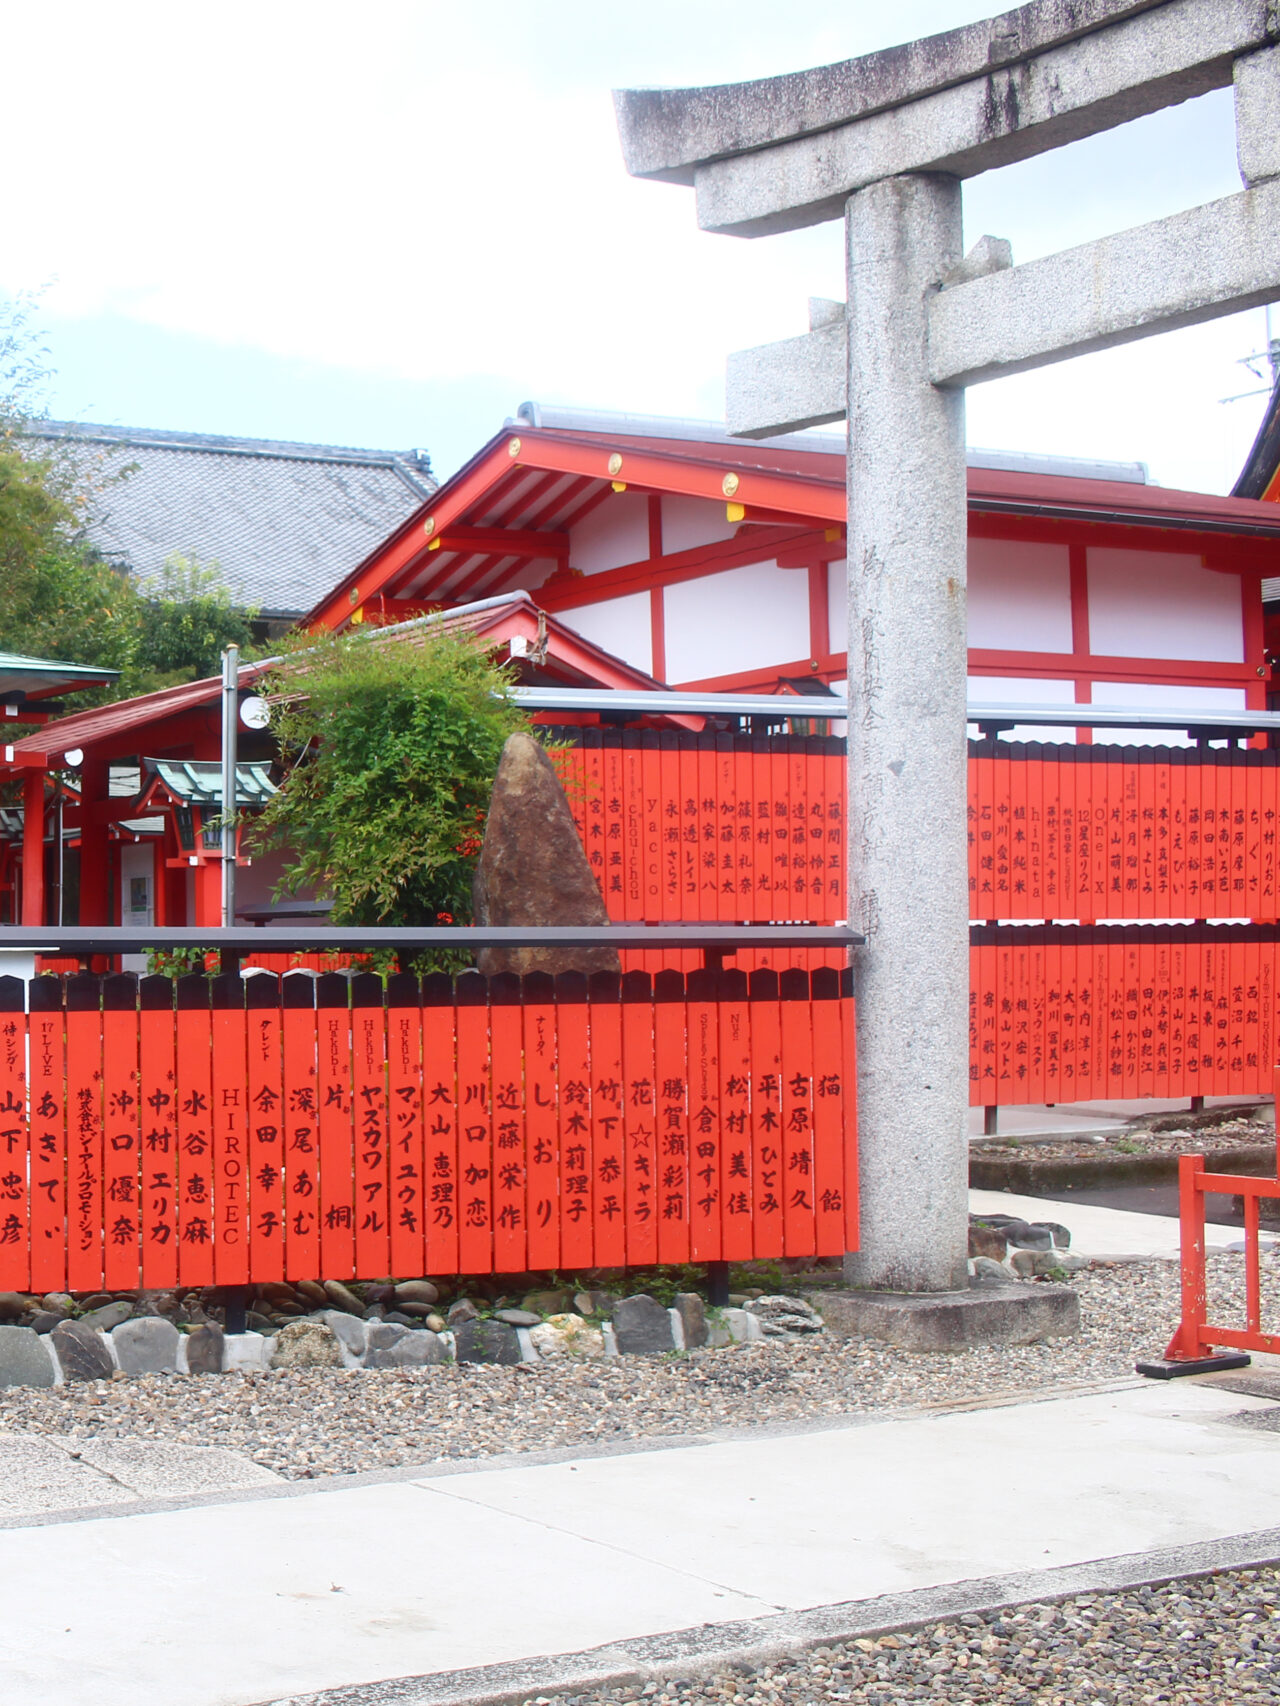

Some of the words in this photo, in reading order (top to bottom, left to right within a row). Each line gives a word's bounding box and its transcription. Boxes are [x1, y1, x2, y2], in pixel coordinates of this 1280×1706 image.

[648, 800, 657, 895] yacco
[1032, 807, 1040, 897] hinata
[0, 1090, 23, 1244] 山下忠彦
[107, 1090, 135, 1245] 沖口優奈
[146, 1088, 172, 1245] 中村エリカ
[182, 1090, 210, 1245] 水谷恵麻
[222, 1089, 240, 1244] HIROTEC
[289, 1088, 315, 1236] 深尾あむ
[497, 1083, 522, 1230] 近藤栄作
[533, 1083, 553, 1228] しおり
